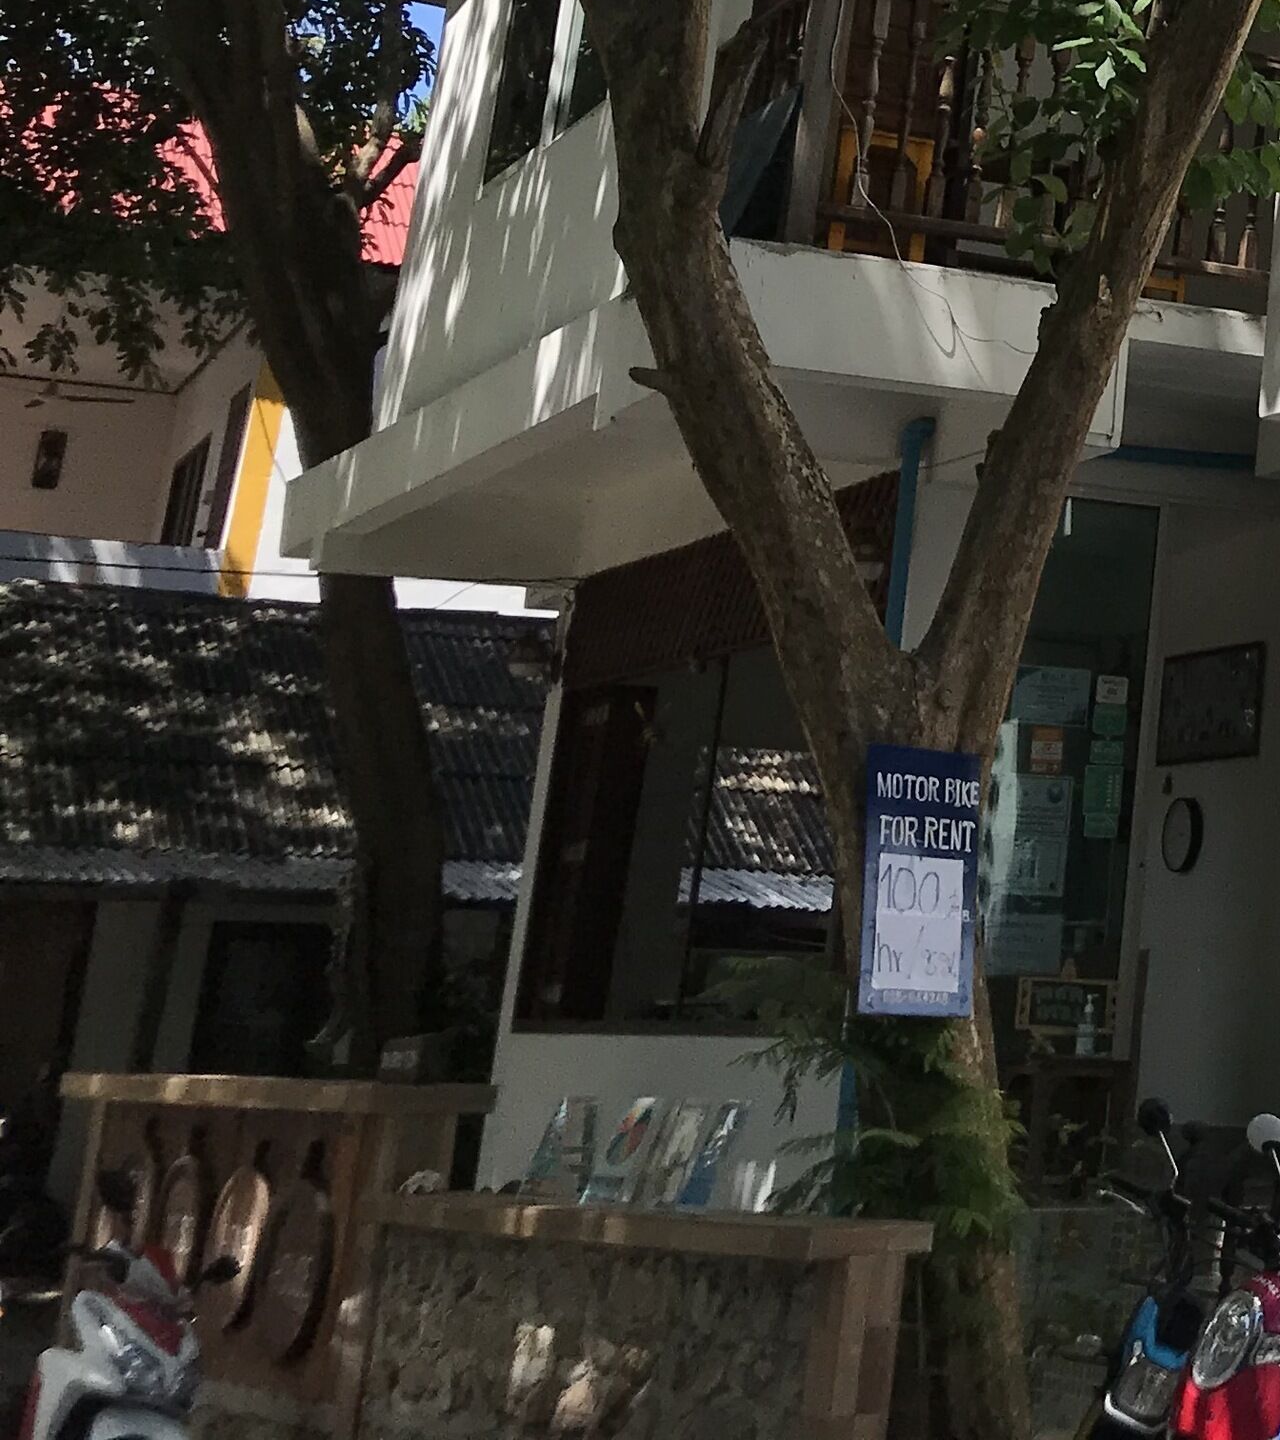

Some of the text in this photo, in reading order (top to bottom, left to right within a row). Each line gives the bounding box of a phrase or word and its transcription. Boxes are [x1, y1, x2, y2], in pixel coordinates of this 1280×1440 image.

[877, 771, 980, 809] MOTOR BIKE
[879, 814, 976, 853] FOR RENT
[880, 863, 940, 914] 100
